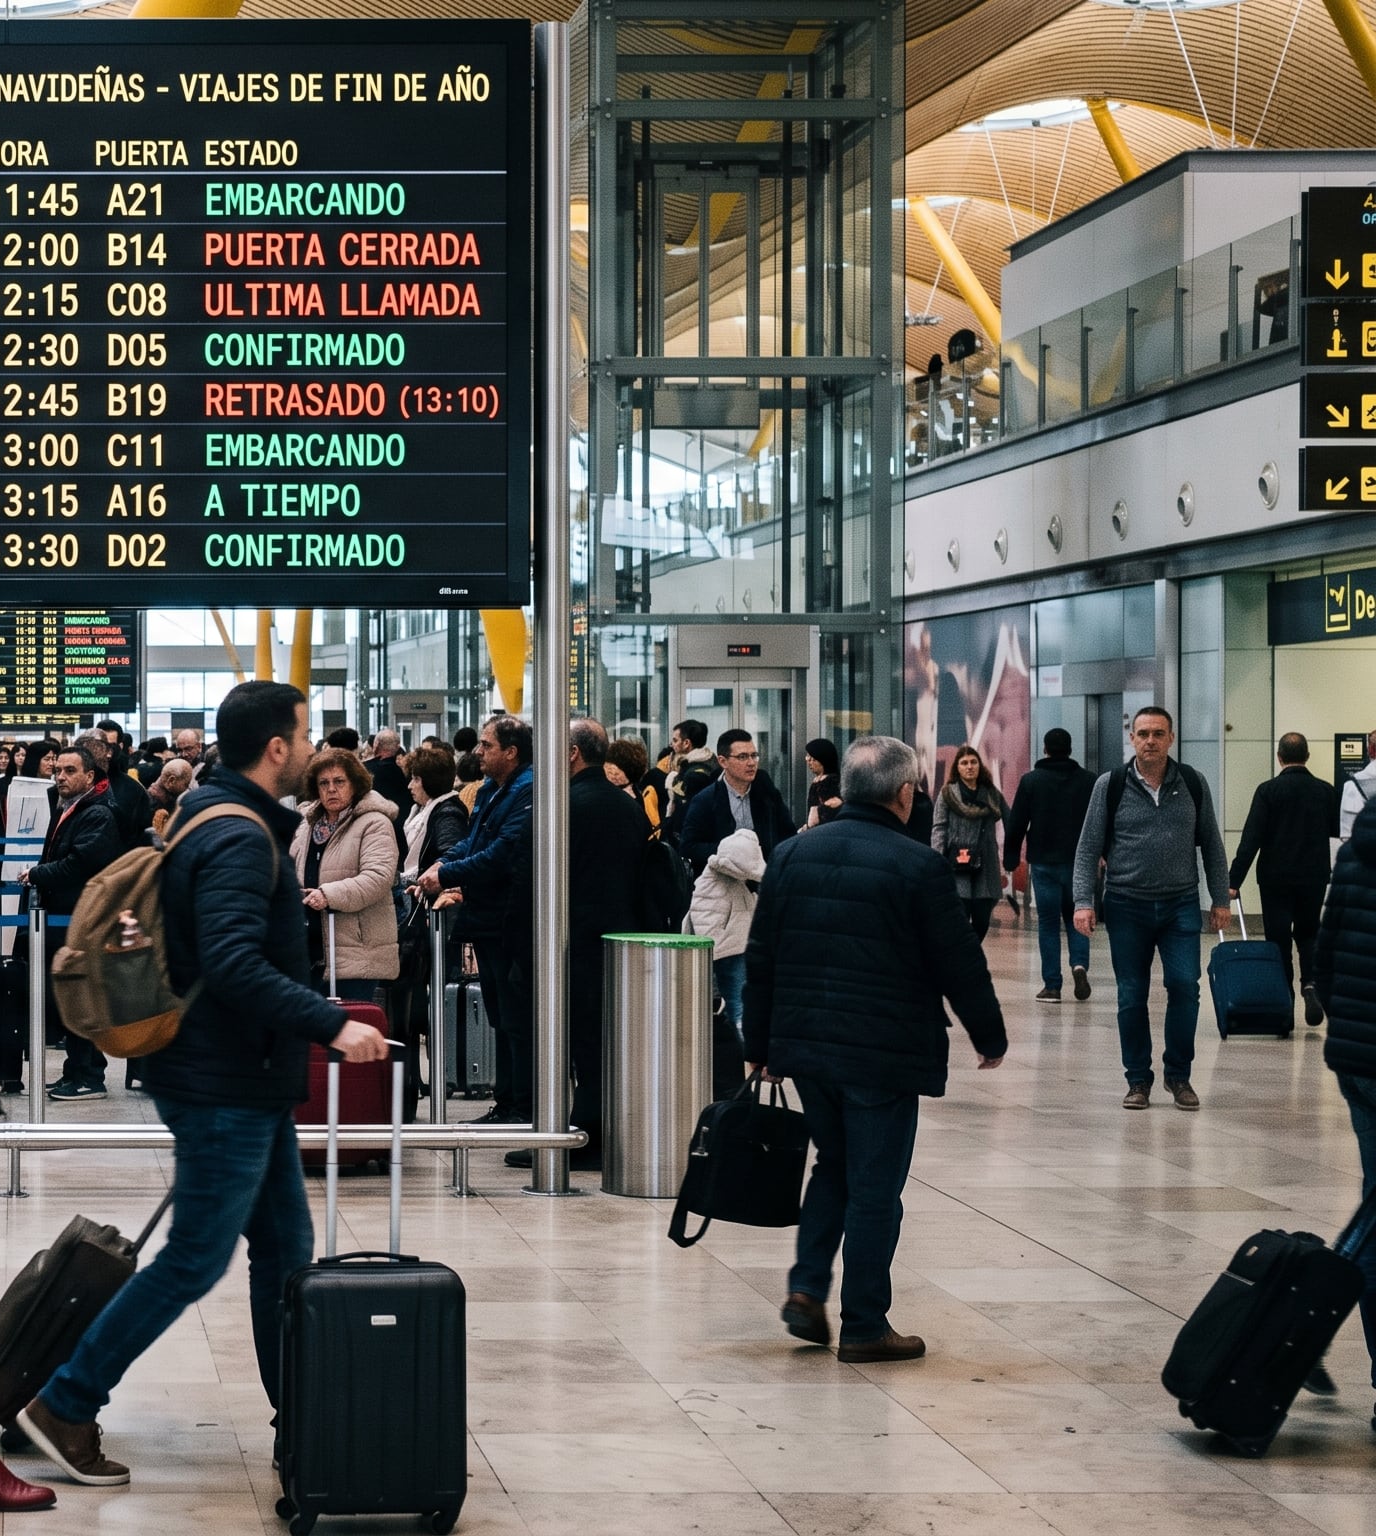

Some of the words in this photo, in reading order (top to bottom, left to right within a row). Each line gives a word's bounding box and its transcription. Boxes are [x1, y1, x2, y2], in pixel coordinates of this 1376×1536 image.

[180, 73, 279, 102] VIAJES
[291, 74, 323, 102] DE
[336, 74, 381, 102] FIN
[394, 74, 426, 102] DE
[438, 65, 489, 102] AÑO
[96, 141, 188, 166] PUERTA
[206, 141, 297, 166] ESTADO
[107, 183, 161, 216] A21
[206, 183, 405, 216] EMBARCANDO
[108, 233, 166, 266] B14
[205, 233, 325, 266] PUERTA
[340, 233, 480, 266] CERRADA
[108, 283, 166, 317] C08
[205, 283, 325, 316] ULTIMA
[341, 283, 480, 316] LLAMADA
[108, 334, 166, 366] D05
[205, 333, 404, 366] CONFIRMADO
[108, 384, 166, 416] B19
[206, 383, 385, 416] RETRASADO
[399, 385, 499, 419] (13:10)
[108, 434, 161, 466] C11
[206, 434, 405, 466] EMBARCANDO
[107, 484, 166, 517] A16
[204, 484, 224, 516] A
[241, 484, 360, 516] TIEMPO
[108, 534, 166, 567] D02
[205, 534, 405, 567] CONFIRMADO
